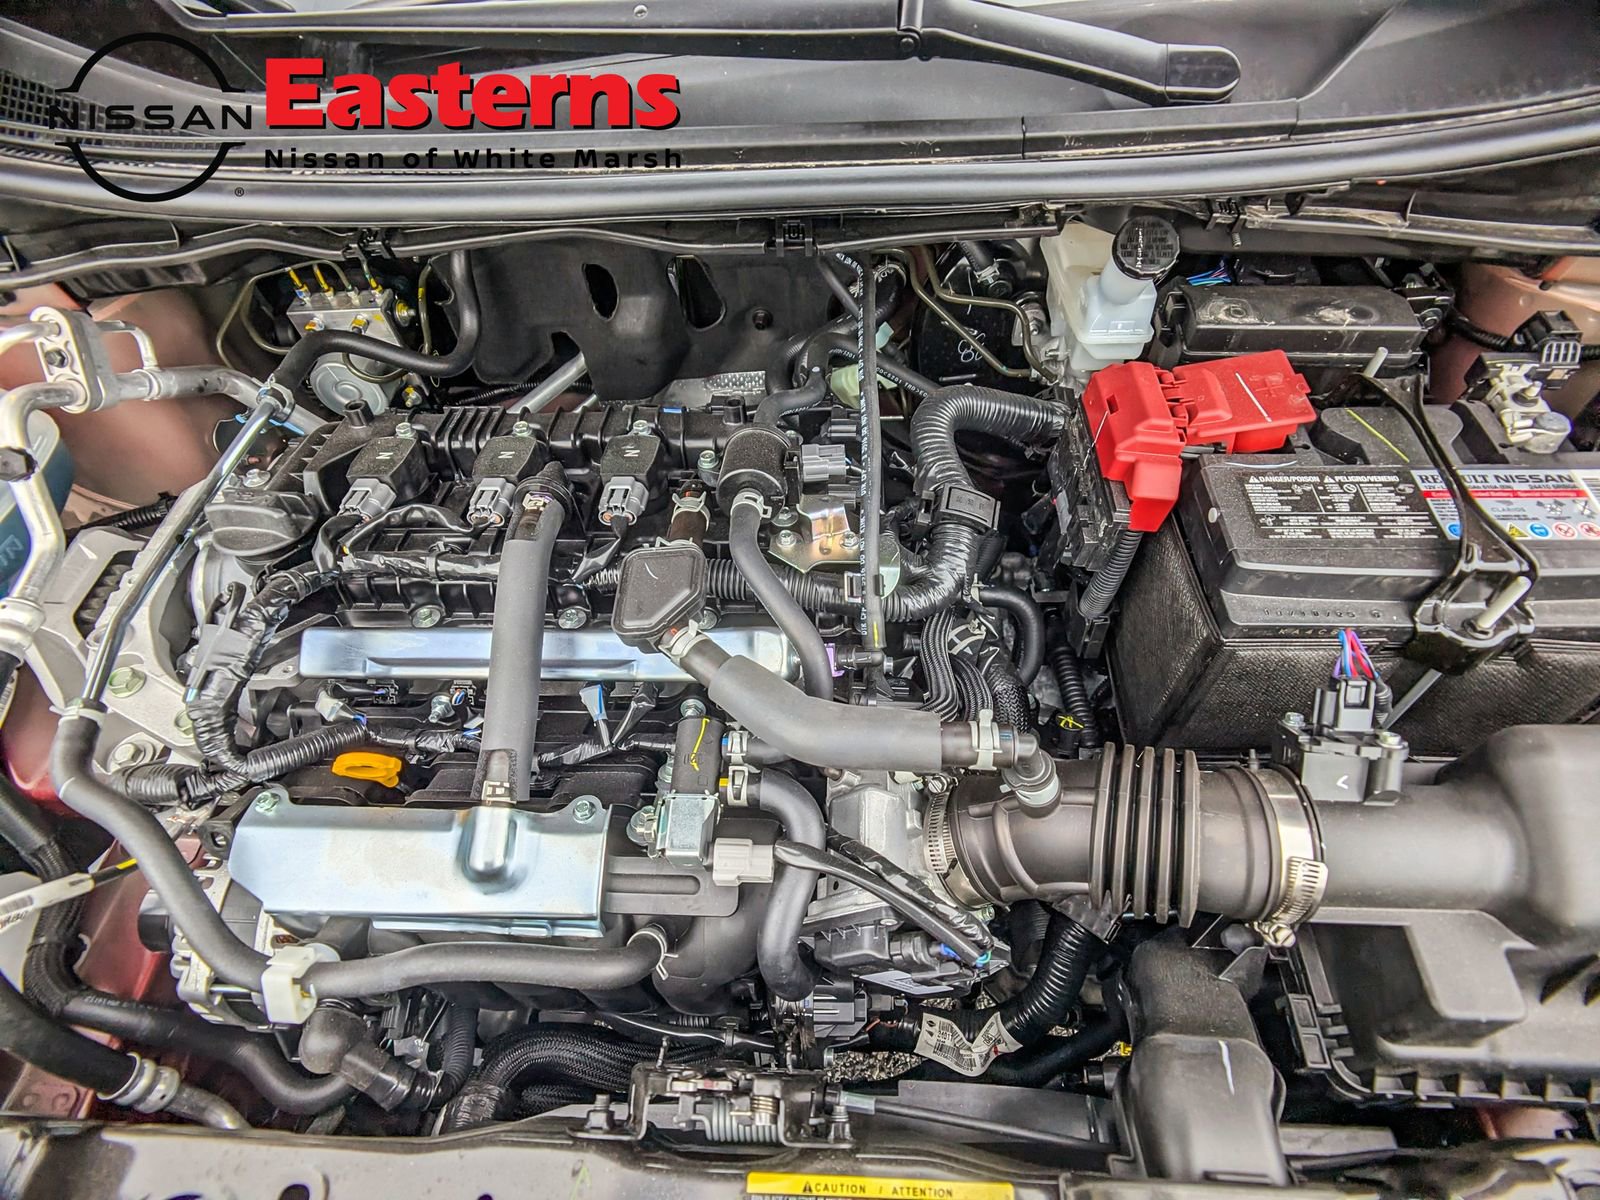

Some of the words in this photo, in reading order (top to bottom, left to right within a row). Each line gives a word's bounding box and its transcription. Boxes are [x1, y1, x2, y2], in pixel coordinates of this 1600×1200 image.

[1259, 475, 1321, 483] DANGER/POISON
[1334, 475, 1400, 483] PELIGRO/VENENO
[1418, 475, 1489, 484] REULT
[1494, 474, 1574, 484] NISSAN
[814, 1183, 866, 1194] CAUTION
[891, 1185, 953, 1197] ATTENTION
